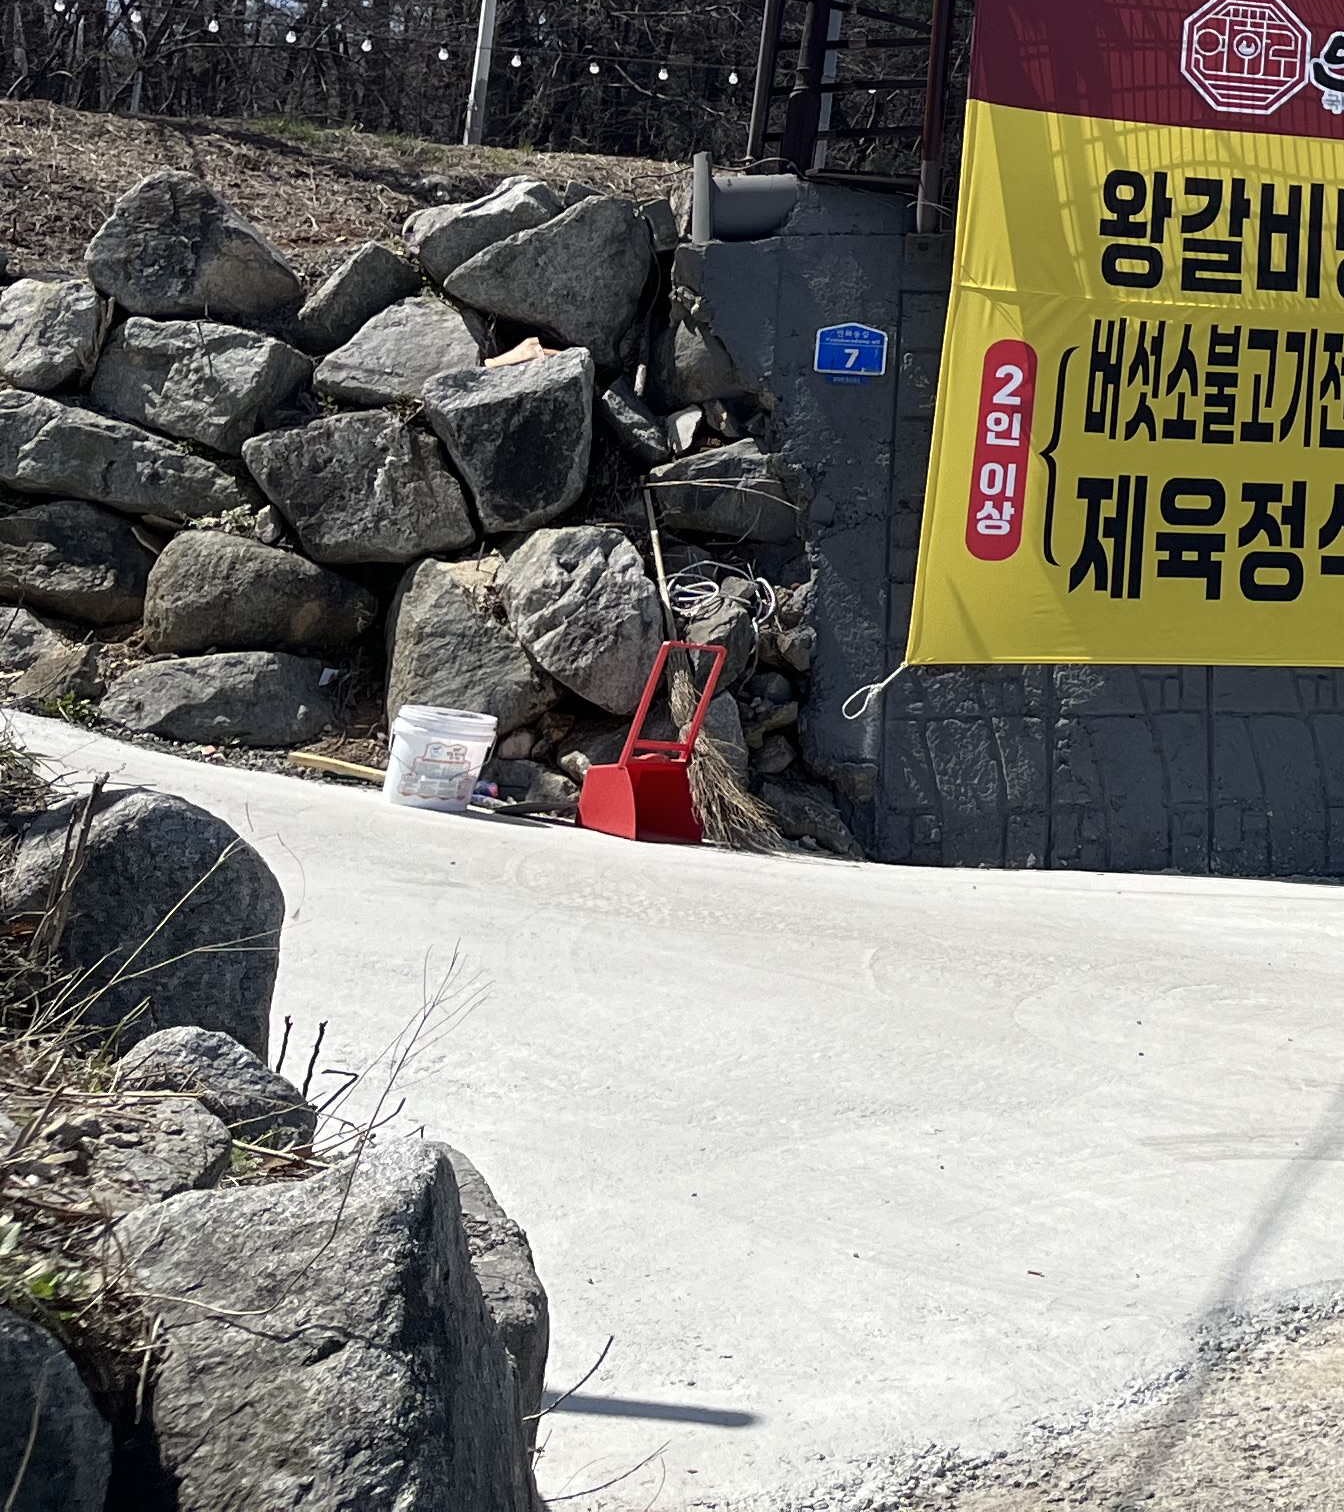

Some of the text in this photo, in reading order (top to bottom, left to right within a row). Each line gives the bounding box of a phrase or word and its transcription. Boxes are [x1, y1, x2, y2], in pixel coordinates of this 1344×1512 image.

[844, 349, 859, 368] 7
[975, 364, 1025, 536] 2인 이상
